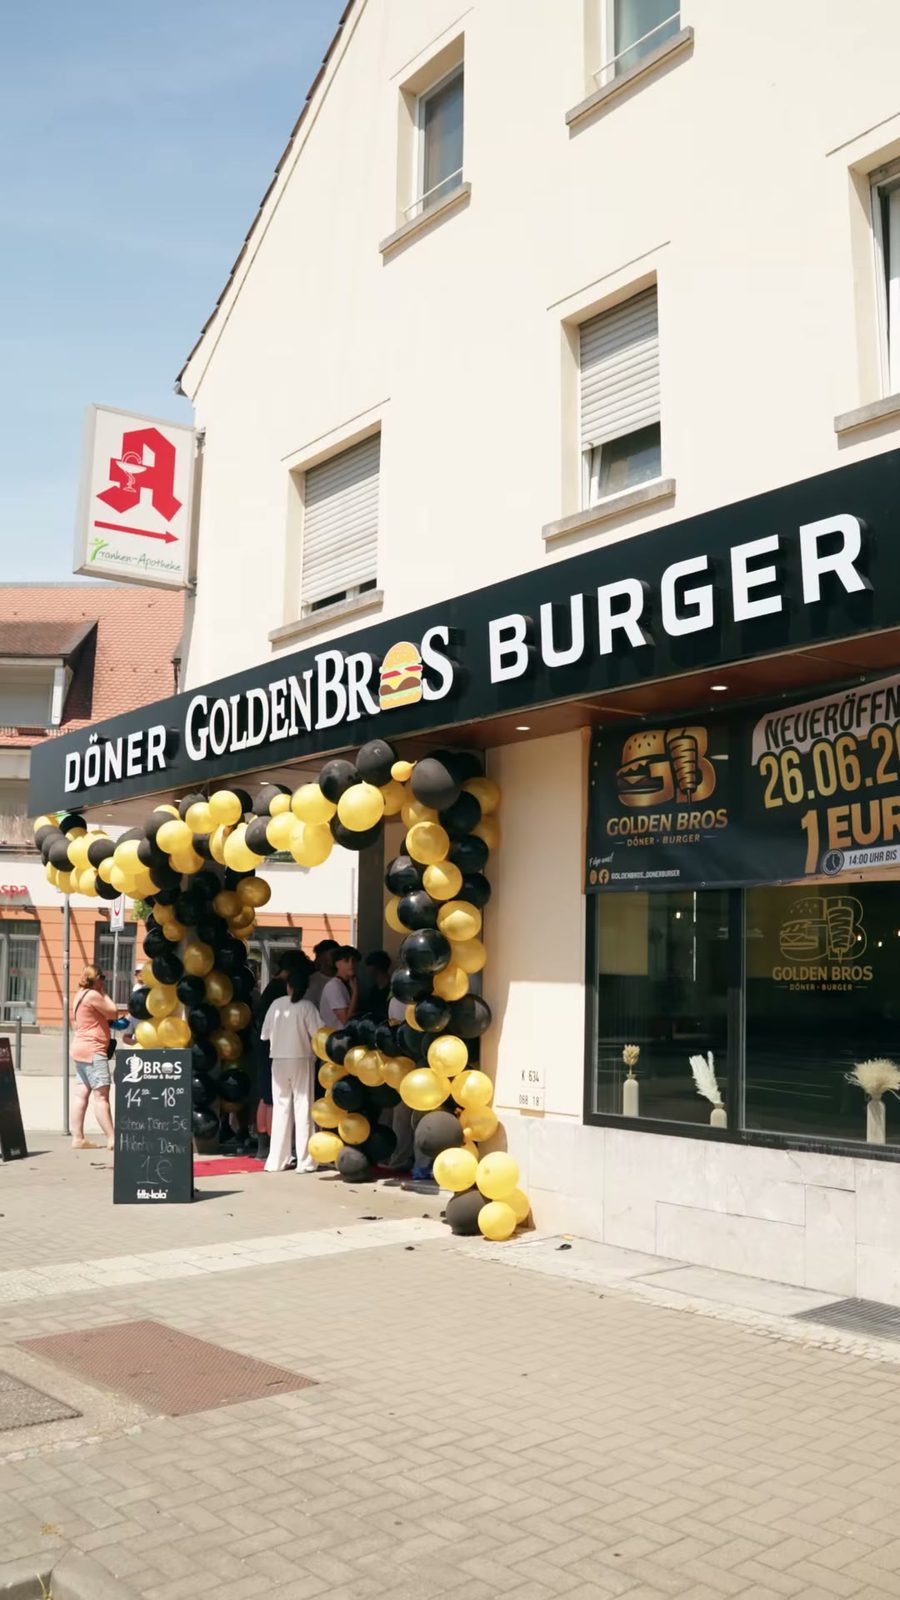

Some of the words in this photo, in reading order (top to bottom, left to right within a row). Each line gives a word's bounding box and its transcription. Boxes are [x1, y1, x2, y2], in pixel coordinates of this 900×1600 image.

[64, 732, 167, 792] DÖNER
[489, 513, 866, 684] BURGER
[606, 813, 672, 836] GOLDEN
[676, 809, 728, 831] BROS
[627, 835, 655, 847] DÖNER
[662, 834, 700, 845] BURGER
[801, 810, 820, 874] 1
[848, 854, 868, 866] 14:00
[870, 851, 885, 863] UHR
[885, 849, 898, 861] BIS
[772, 965, 828, 981] GOLDEN
[831, 965, 873, 981] BROS
[789, 983, 815, 991] DÖNER
[821, 983, 853, 991] BURGER
